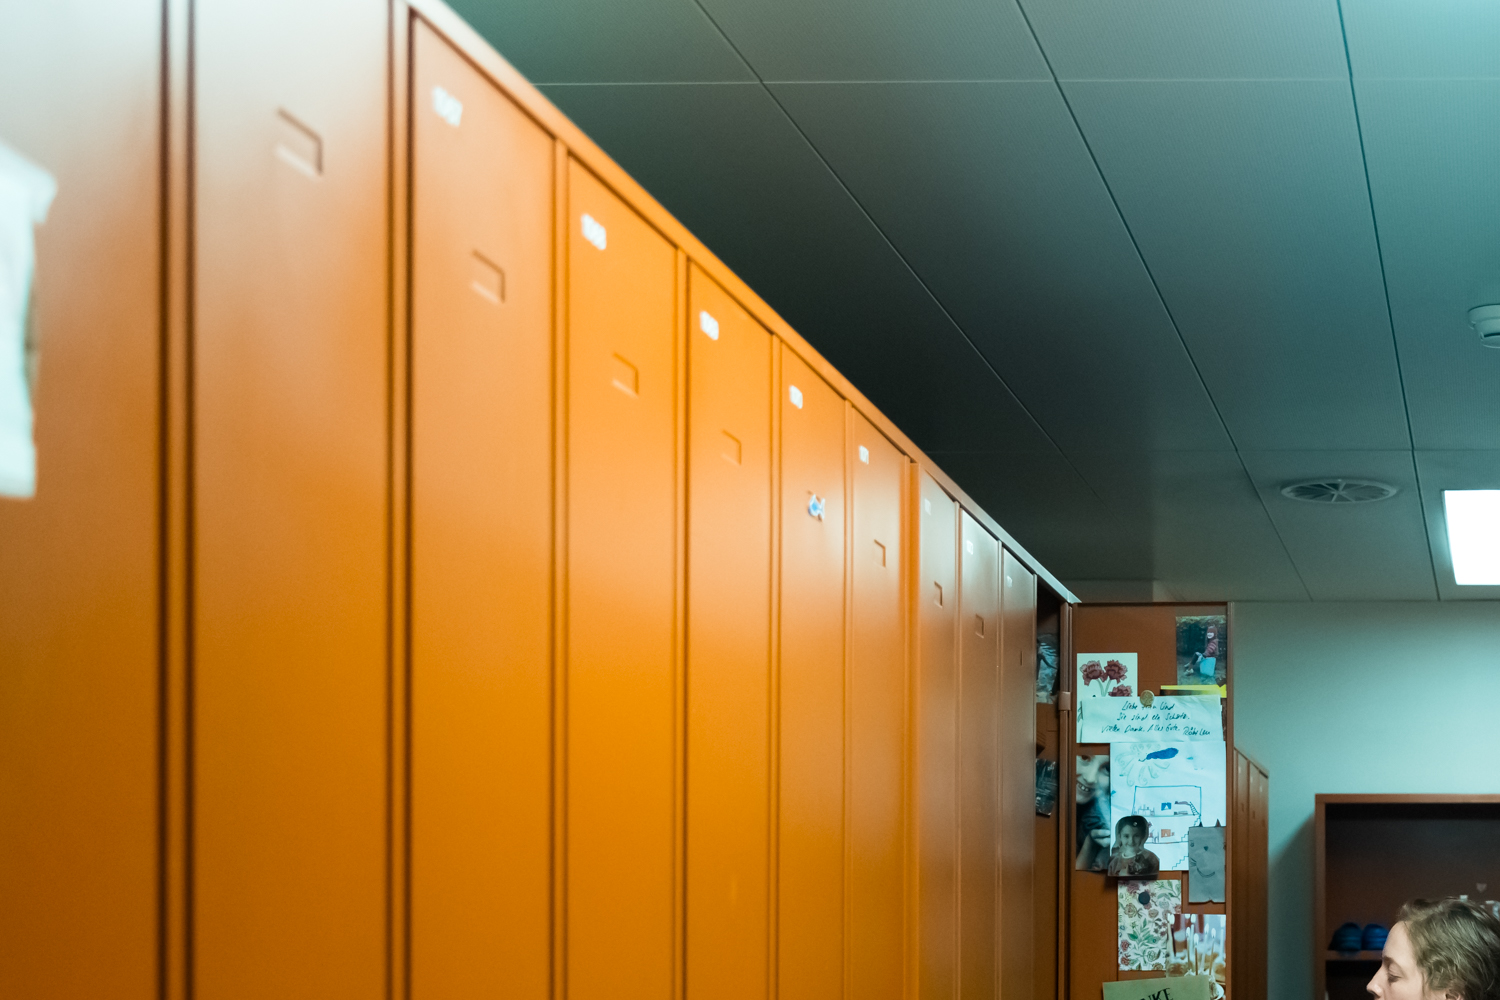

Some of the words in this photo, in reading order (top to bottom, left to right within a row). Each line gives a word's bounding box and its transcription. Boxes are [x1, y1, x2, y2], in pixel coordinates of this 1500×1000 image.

[1122, 701, 1138, 711] Liebe
[1116, 712, 1127, 721] Sie
[1131, 713, 1149, 721] sind
